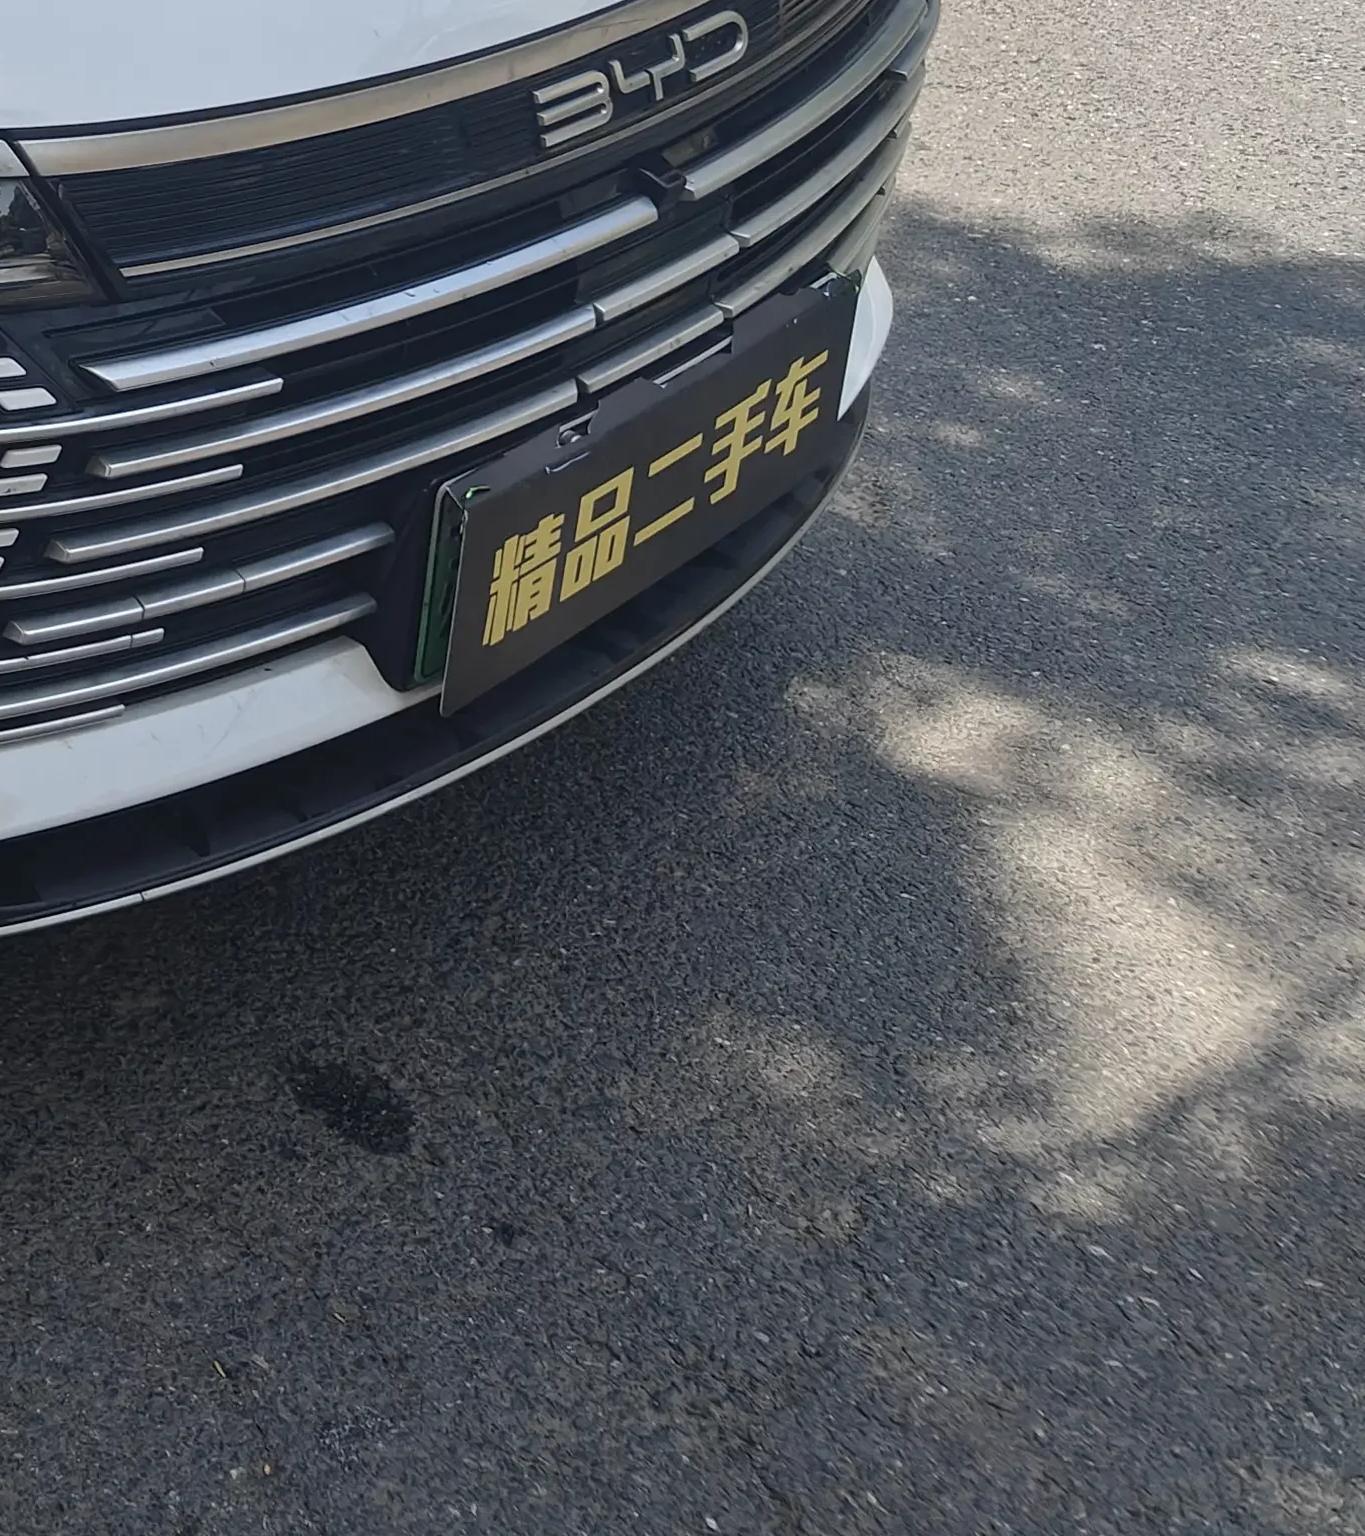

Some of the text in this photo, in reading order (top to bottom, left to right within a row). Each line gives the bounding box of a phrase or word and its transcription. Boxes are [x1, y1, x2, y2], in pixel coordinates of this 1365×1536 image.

[533, 10, 749, 148] BYD
[482, 349, 829, 646] 精品二手车
